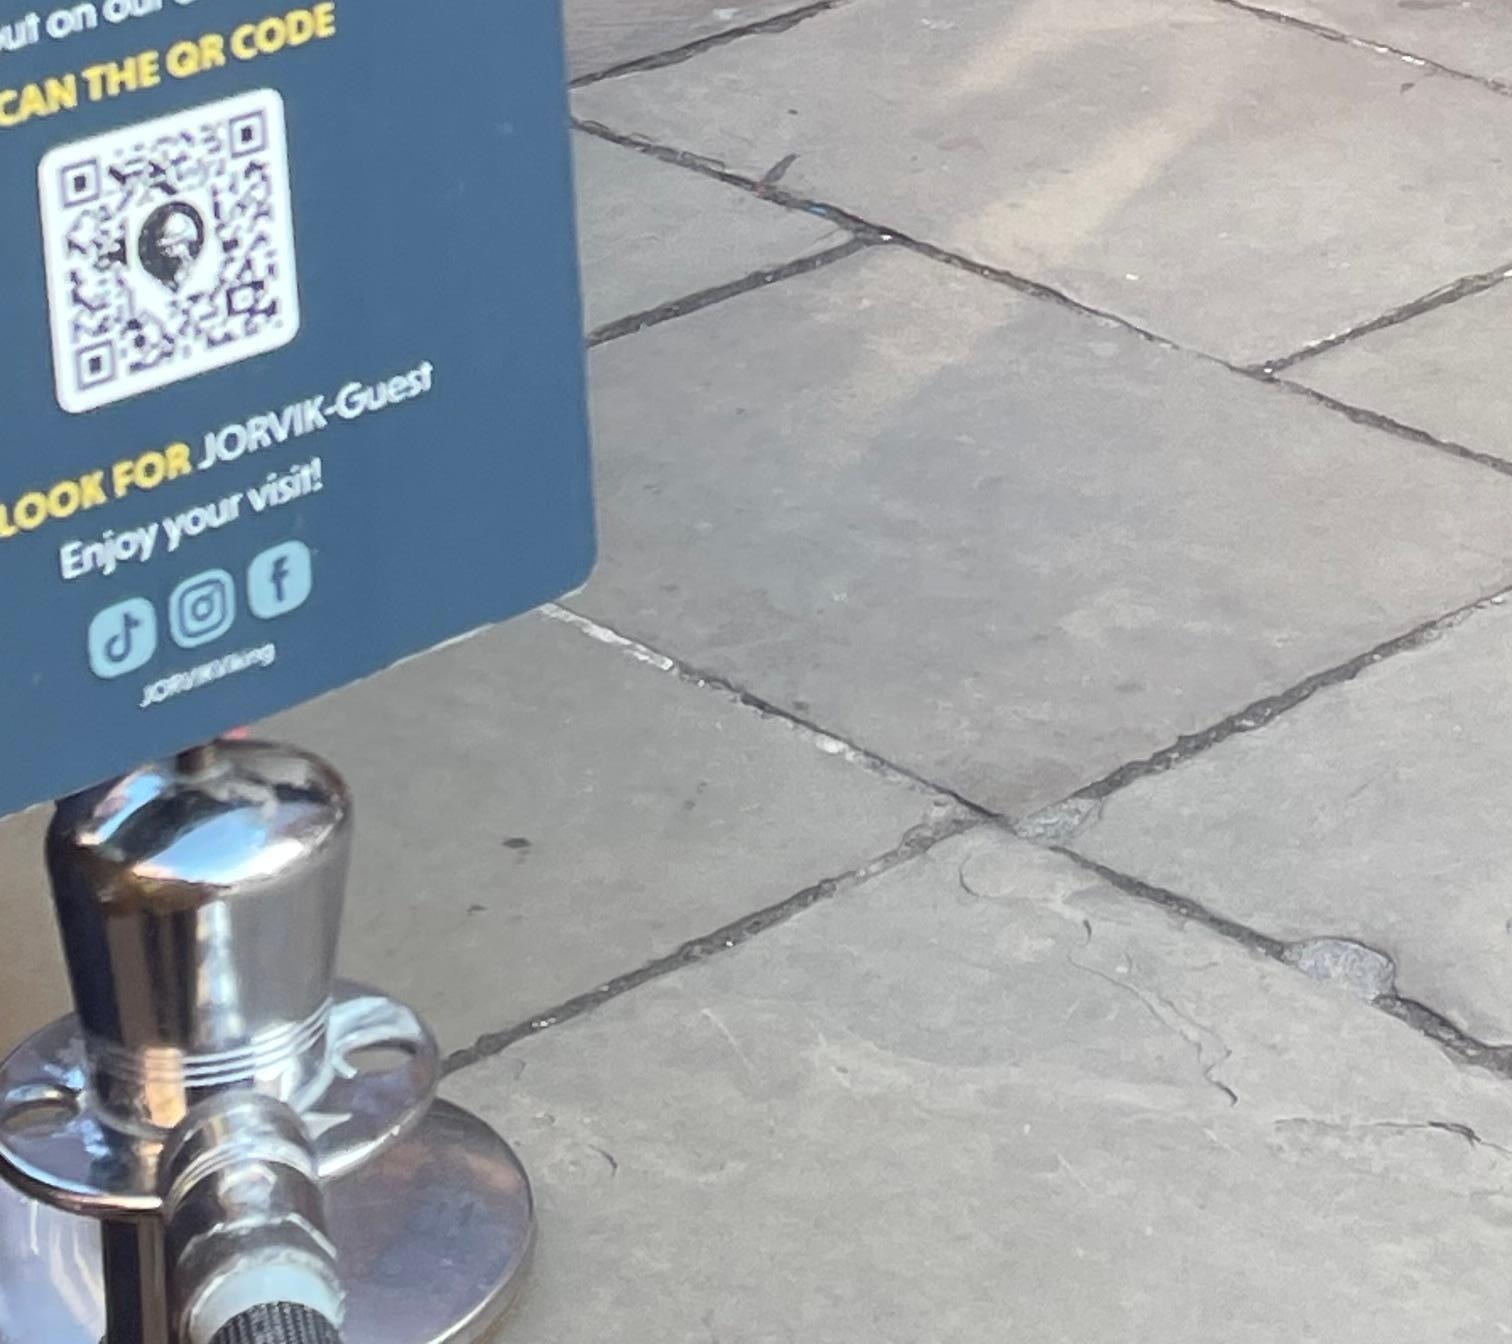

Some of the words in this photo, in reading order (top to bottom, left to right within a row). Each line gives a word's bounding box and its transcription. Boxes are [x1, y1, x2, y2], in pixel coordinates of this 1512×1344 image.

[0, 11, 41, 52] ut
[46, 2, 98, 39] on
[0, 73, 78, 127] CAN
[81, 49, 162, 102] THE
[165, 33, 227, 79] QR
[230, 1, 337, 60] CODE
[0, 469, 108, 538] LOOK
[112, 442, 193, 498] FOR
[197, 360, 434, 471] JORVIK-Guest
[60, 515, 160, 581] Enjoy
[162, 492, 244, 553] your
[247, 456, 324, 512] visit!
